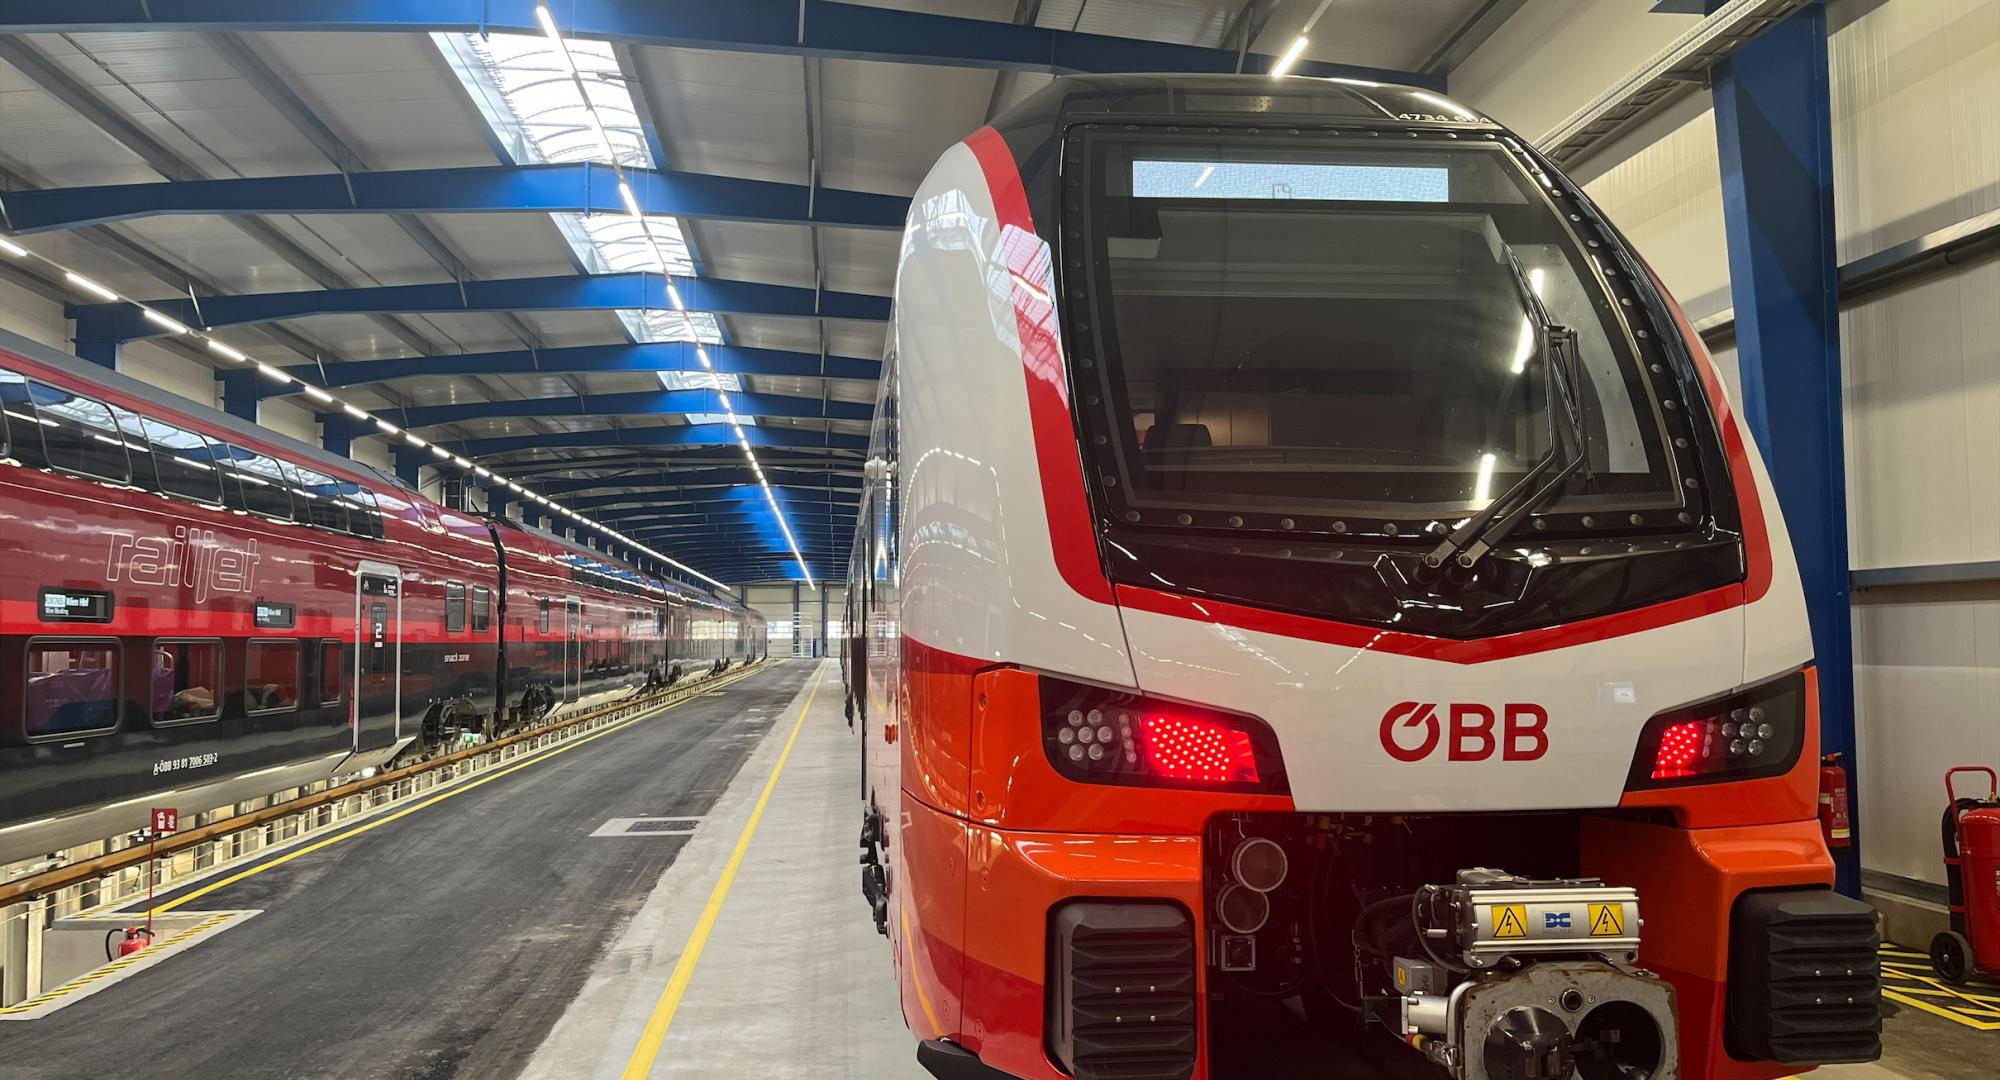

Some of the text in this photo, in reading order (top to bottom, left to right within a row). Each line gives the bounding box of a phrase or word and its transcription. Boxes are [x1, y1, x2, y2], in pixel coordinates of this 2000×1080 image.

[107, 526, 260, 604] railjet
[375, 622, 383, 639] 2
[1379, 701, 1549, 762] ÖBB
[172, 759, 180, 770] 93
[180, 758, 188, 769] 81
